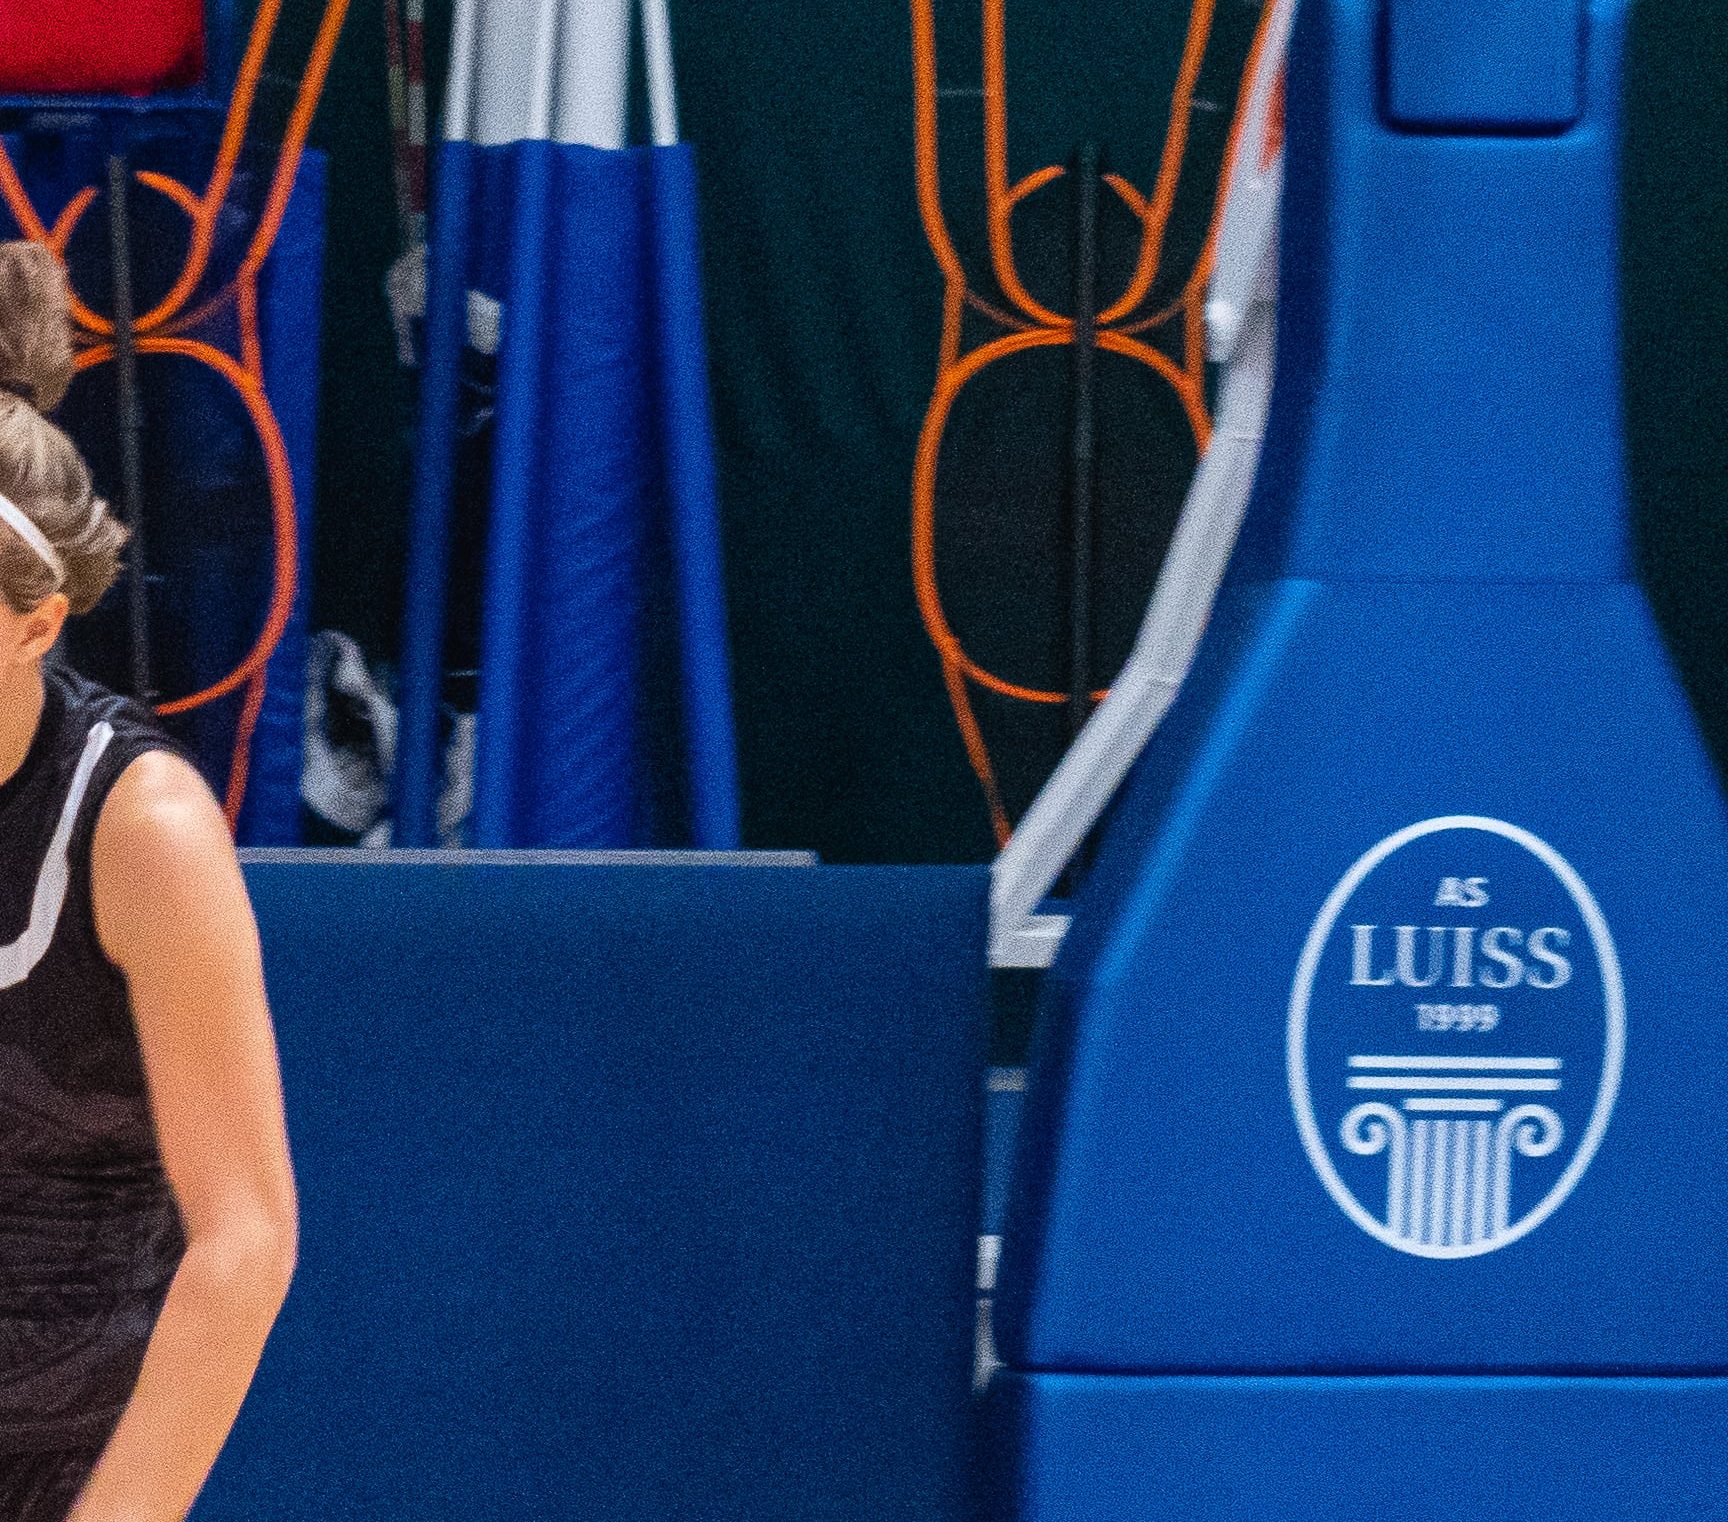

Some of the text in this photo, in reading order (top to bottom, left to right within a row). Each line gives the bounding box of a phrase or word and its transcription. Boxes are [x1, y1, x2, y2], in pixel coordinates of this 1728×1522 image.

[1435, 876, 1490, 908] AS
[1348, 924, 1574, 990] LUISS
[1416, 1003, 1501, 1033] 1999
